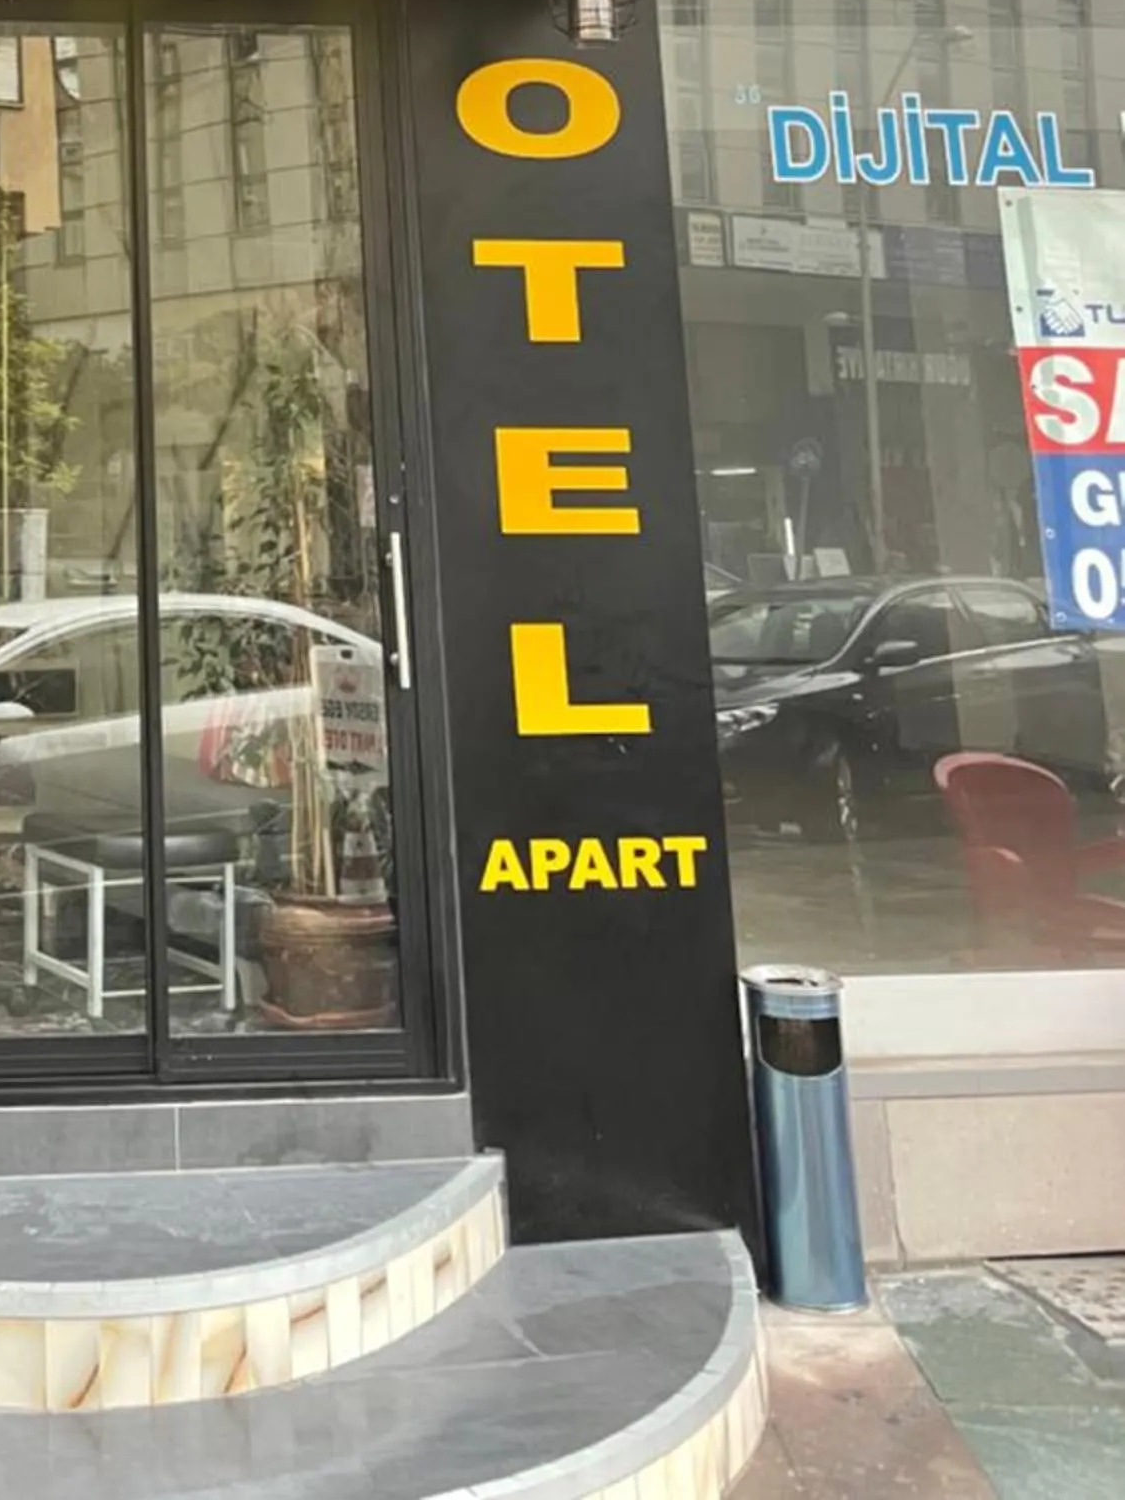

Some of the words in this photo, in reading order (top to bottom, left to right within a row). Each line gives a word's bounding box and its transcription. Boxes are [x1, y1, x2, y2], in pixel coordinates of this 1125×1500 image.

[768, 90, 1095, 188] DİJİTAL
[456, 58, 650, 735] OTEL
[1070, 468, 1125, 527] G
[480, 836, 707, 891] APART
